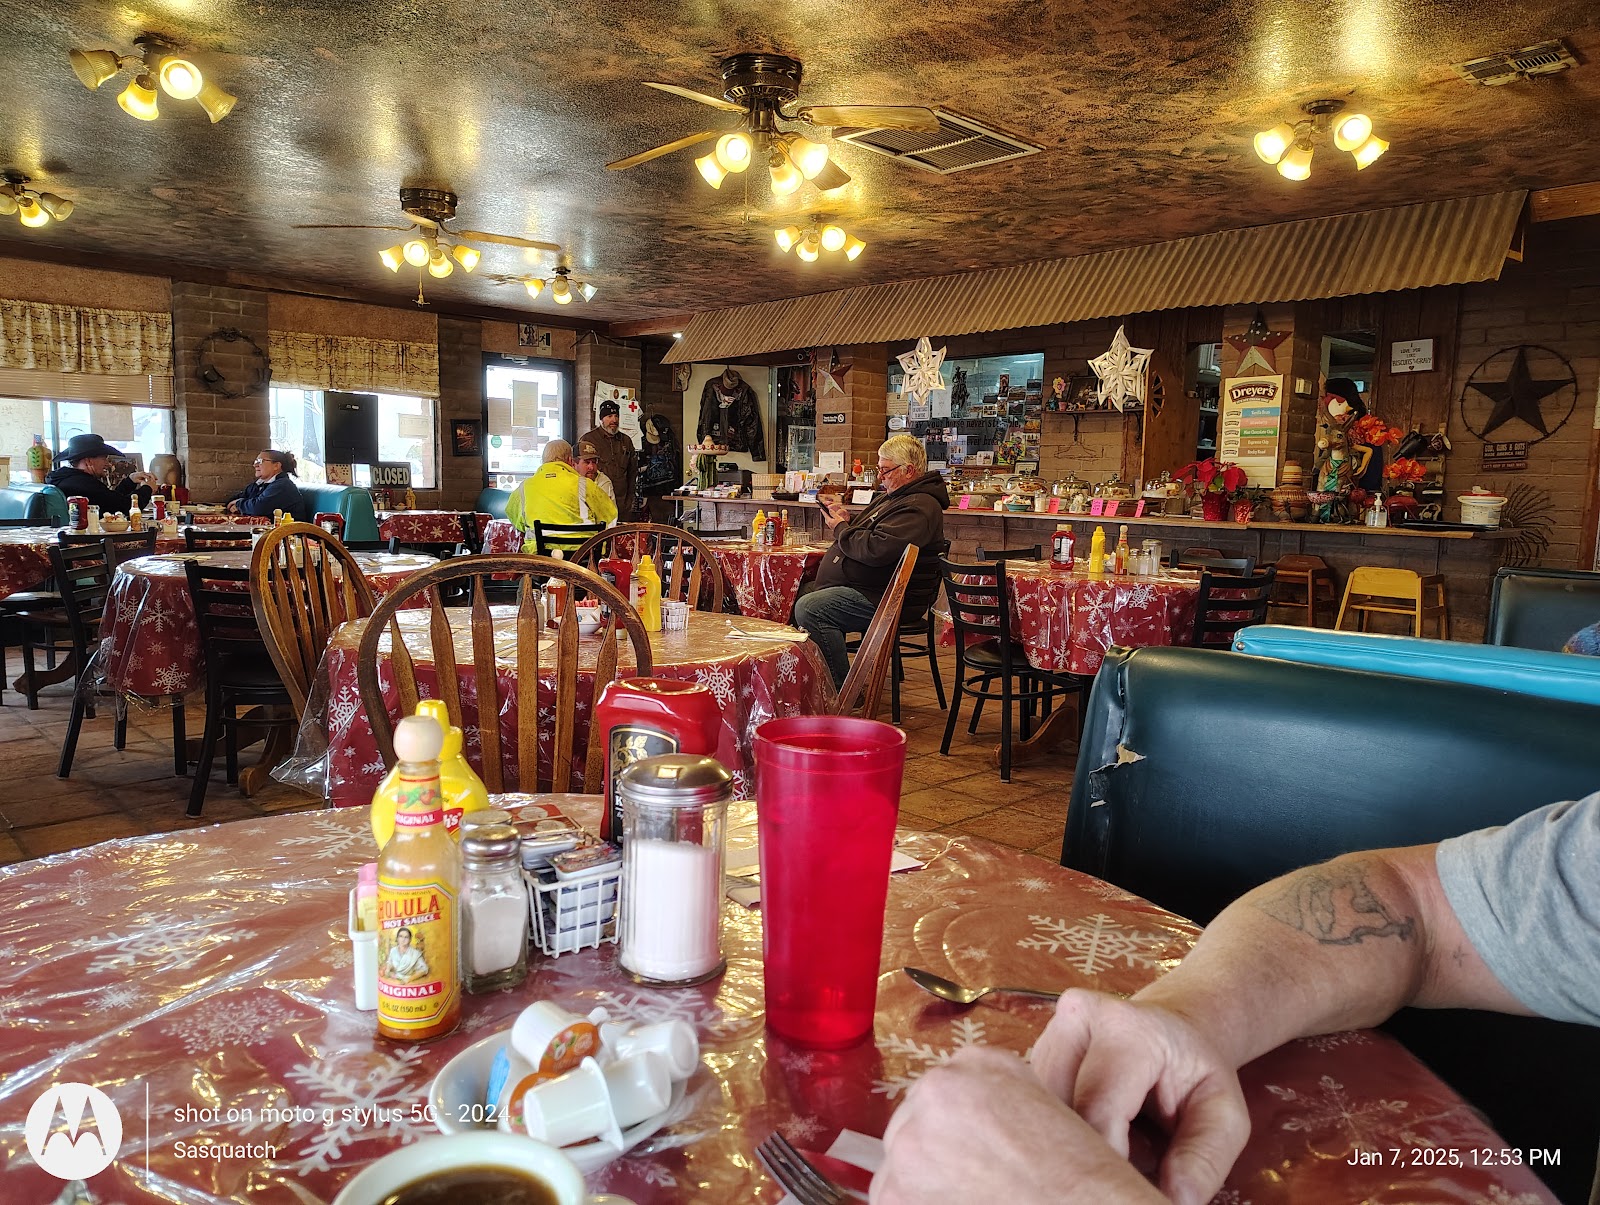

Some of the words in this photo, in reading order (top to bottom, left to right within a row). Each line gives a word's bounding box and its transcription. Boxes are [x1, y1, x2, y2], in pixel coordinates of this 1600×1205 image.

[1232, 385, 1275, 399] Dreyer's
[966, 418, 987, 428] never
[373, 467, 409, 485] CLOSED
[396, 813, 435, 825] RIGINAL
[384, 918, 403, 929] HOT
[403, 914, 436, 926] SAUCE
[379, 982, 436, 997] ORIGINAL
[400, 1005, 413, 1013] (150
